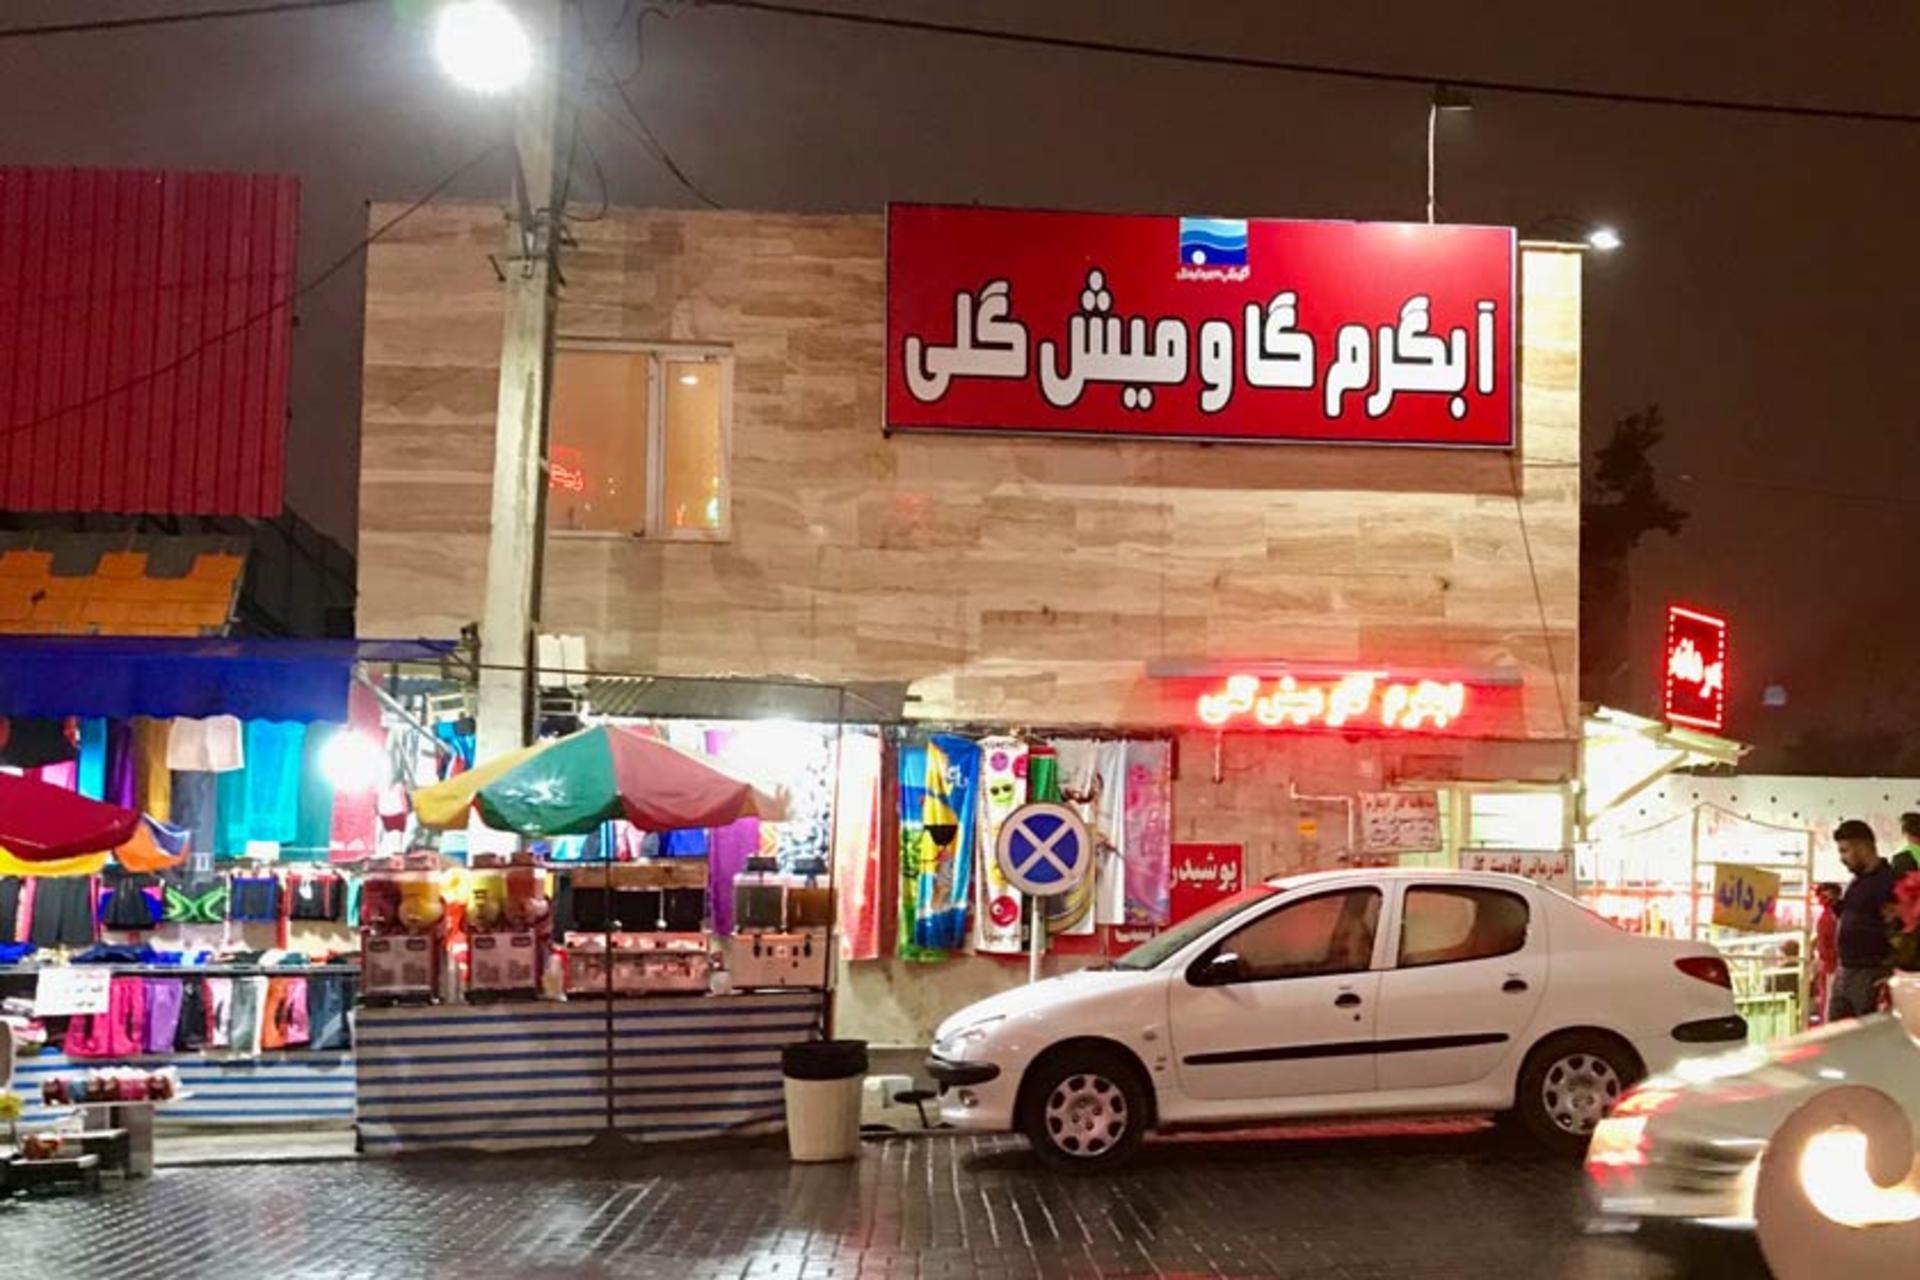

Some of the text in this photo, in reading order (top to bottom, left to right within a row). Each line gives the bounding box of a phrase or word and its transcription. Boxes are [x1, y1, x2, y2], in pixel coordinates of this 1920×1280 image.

[904, 280, 1028, 403] گلی
[1323, 294, 1498, 420] آبگرم
[1197, 674, 1260, 725] گلی
[1381, 680, 1465, 728] آبگرم
